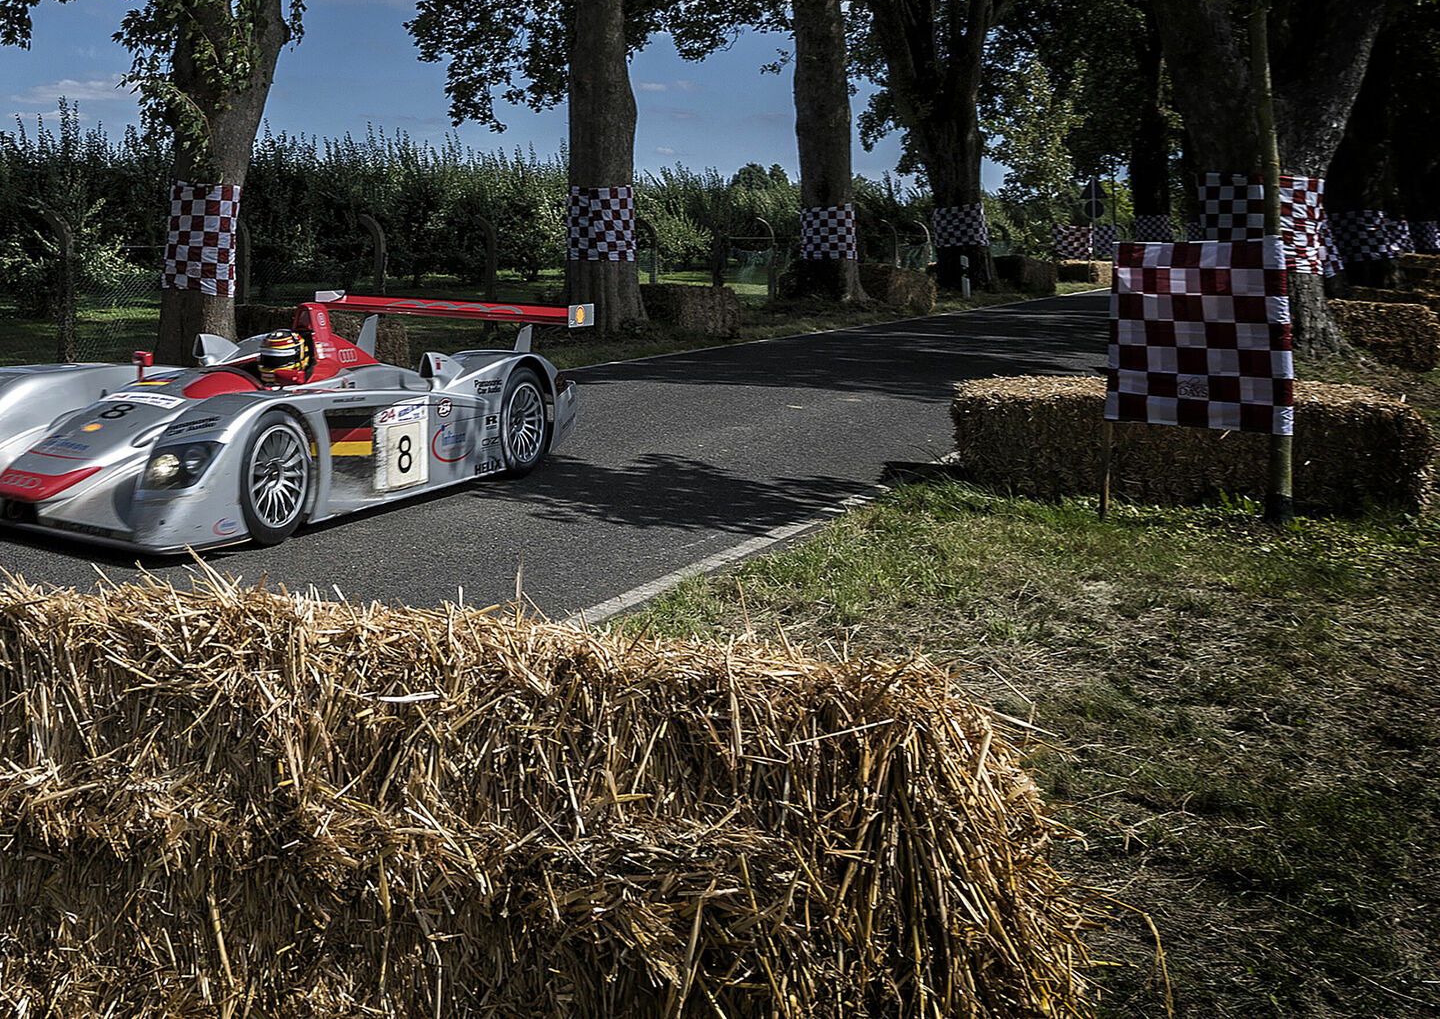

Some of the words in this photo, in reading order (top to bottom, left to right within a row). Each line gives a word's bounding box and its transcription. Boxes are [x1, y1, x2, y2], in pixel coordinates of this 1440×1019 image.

[100, 403, 135, 419] 8
[380, 408, 396, 423] 24
[398, 435, 412, 474] 8
[474, 458, 502, 476] HELIX
